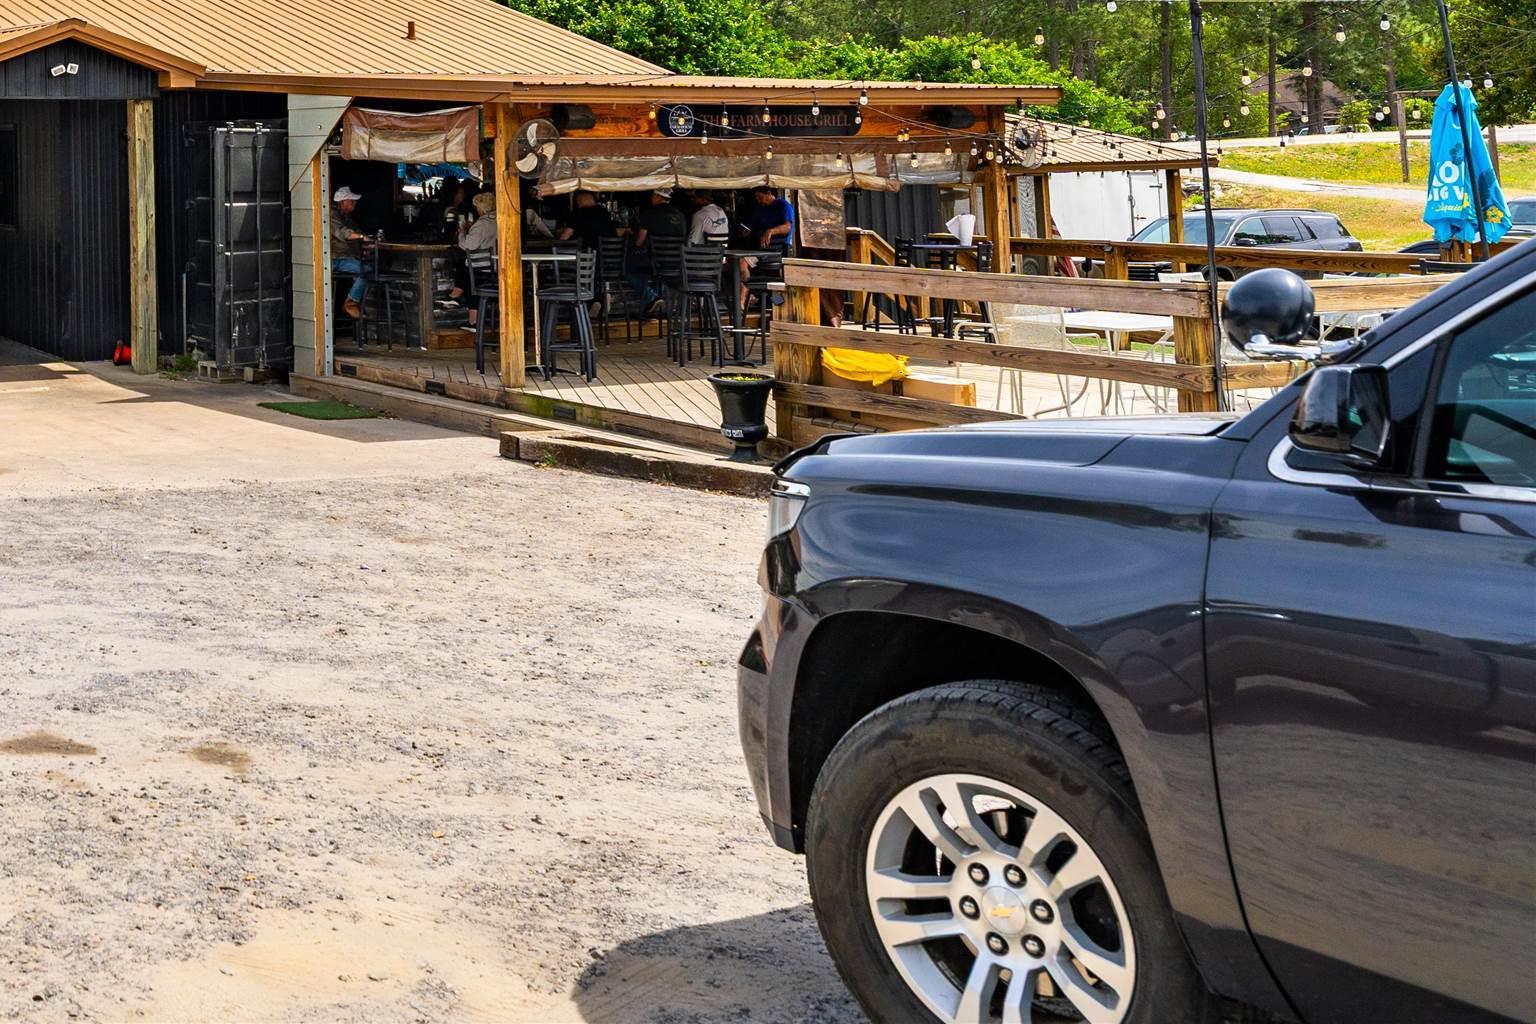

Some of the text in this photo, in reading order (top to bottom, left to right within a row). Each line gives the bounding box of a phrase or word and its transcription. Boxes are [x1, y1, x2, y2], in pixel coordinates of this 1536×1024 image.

[701, 114, 729, 127] TH
[769, 115, 811, 127] HOUSE
[815, 114, 852, 127] GRILL
